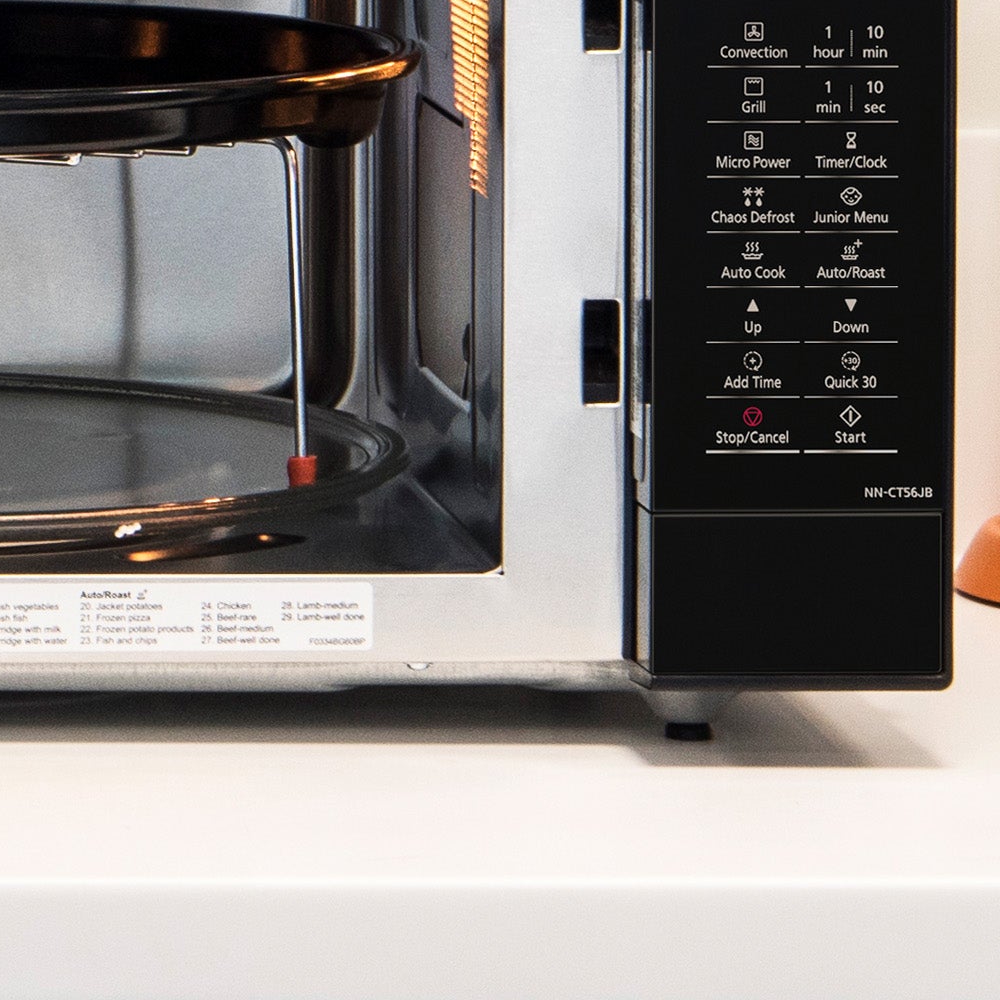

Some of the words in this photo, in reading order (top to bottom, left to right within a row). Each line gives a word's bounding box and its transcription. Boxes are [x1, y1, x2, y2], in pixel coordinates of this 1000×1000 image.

[825, 25, 831, 39] 1
[867, 25, 884, 39] 10
[720, 45, 788, 59] Convection
[813, 45, 845, 58] hour
[862, 45, 888, 58] min
[824, 80, 831, 94] 1
[866, 80, 884, 94] 10
[741, 100, 766, 113] Grill
[816, 100, 841, 113] min
[864, 103, 886, 114] sec
[716, 155, 751, 169] Micro
[753, 155, 791, 169] Power
[815, 155, 888, 168] Timer/Clock
[711, 210, 748, 224] Chaos
[750, 210, 795, 224] Defrost
[813, 210, 851, 224] Junior
[854, 210, 889, 224] Menu
[720, 266, 752, 279] Auto
[754, 265, 786, 279] Cook
[816, 266, 886, 279] Auto/Roast
[744, 320, 762, 336] Up
[833, 320, 869, 334] Down
[723, 374, 749, 389] Add
[752, 375, 782, 389] Time
[824, 374, 859, 390] Quick
[862, 375, 877, 389] 30
[716, 430, 789, 446] Stop/Cancel
[834, 430, 866, 444] Start
[864, 486, 933, 498] NN-CT56JB
[80, 590, 131, 599] Auto/Roast
[13, 603, 59, 612] vegetables
[126, 603, 163, 612] potatoes
[217, 602, 251, 610] Chicken
[96, 614, 126, 622] Frozen
[128, 614, 151, 623] pizza
[217, 612, 257, 621] Beef-rare
[297, 612, 341, 621] Lamb-well
[344, 613, 364, 621] done
[128, 626, 155, 634] potato
[158, 626, 194, 634] products
[217, 624, 274, 632] Beef-medium
[136, 637, 158, 646] chips
[217, 636, 256, 644] Beef-well
[259, 636, 280, 644] done
